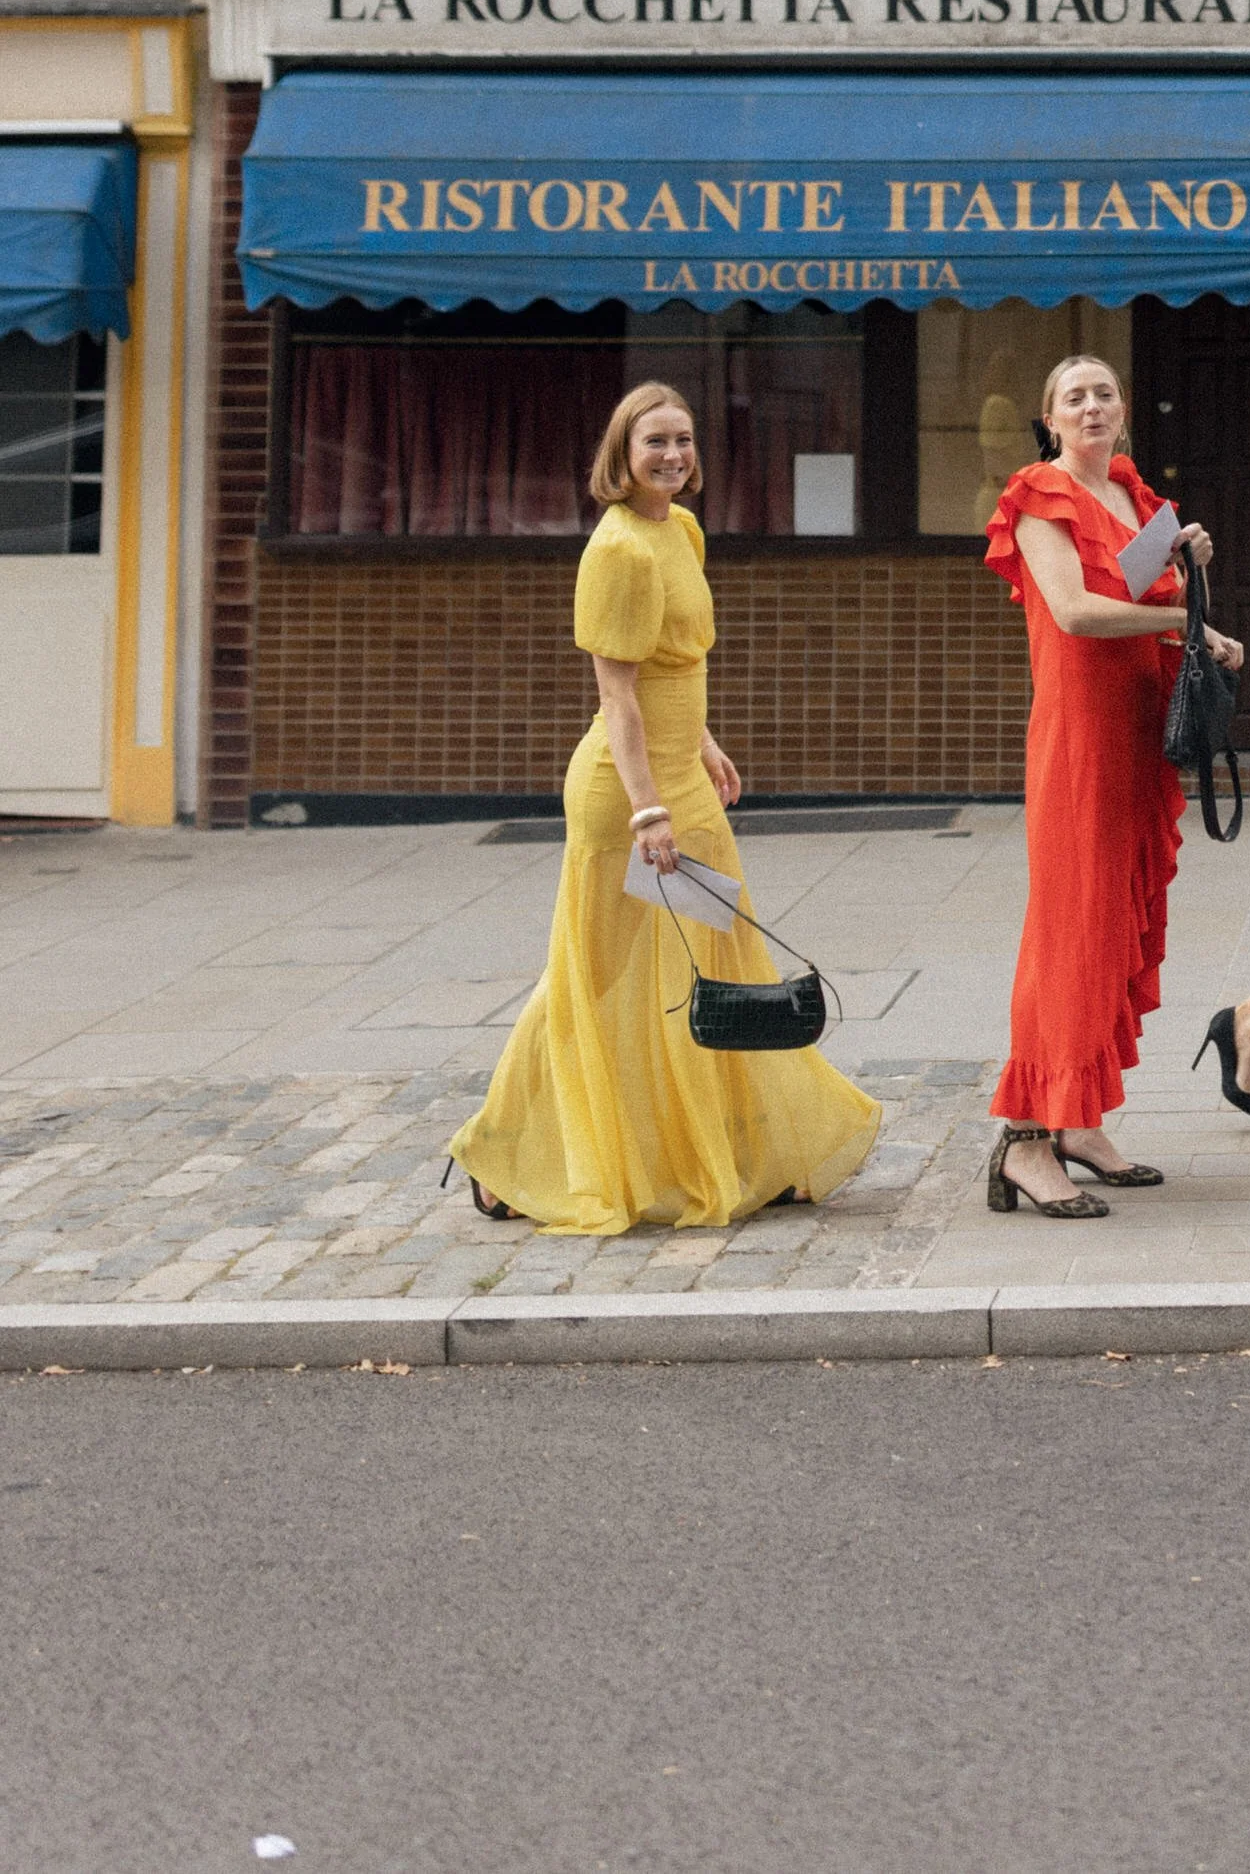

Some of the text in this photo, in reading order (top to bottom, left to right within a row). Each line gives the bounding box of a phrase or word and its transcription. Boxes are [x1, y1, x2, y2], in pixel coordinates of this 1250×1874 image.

[361, 179, 1248, 232] RISTORANTE ITALIANO
[643, 260, 961, 292] LA ROCCHETTA
